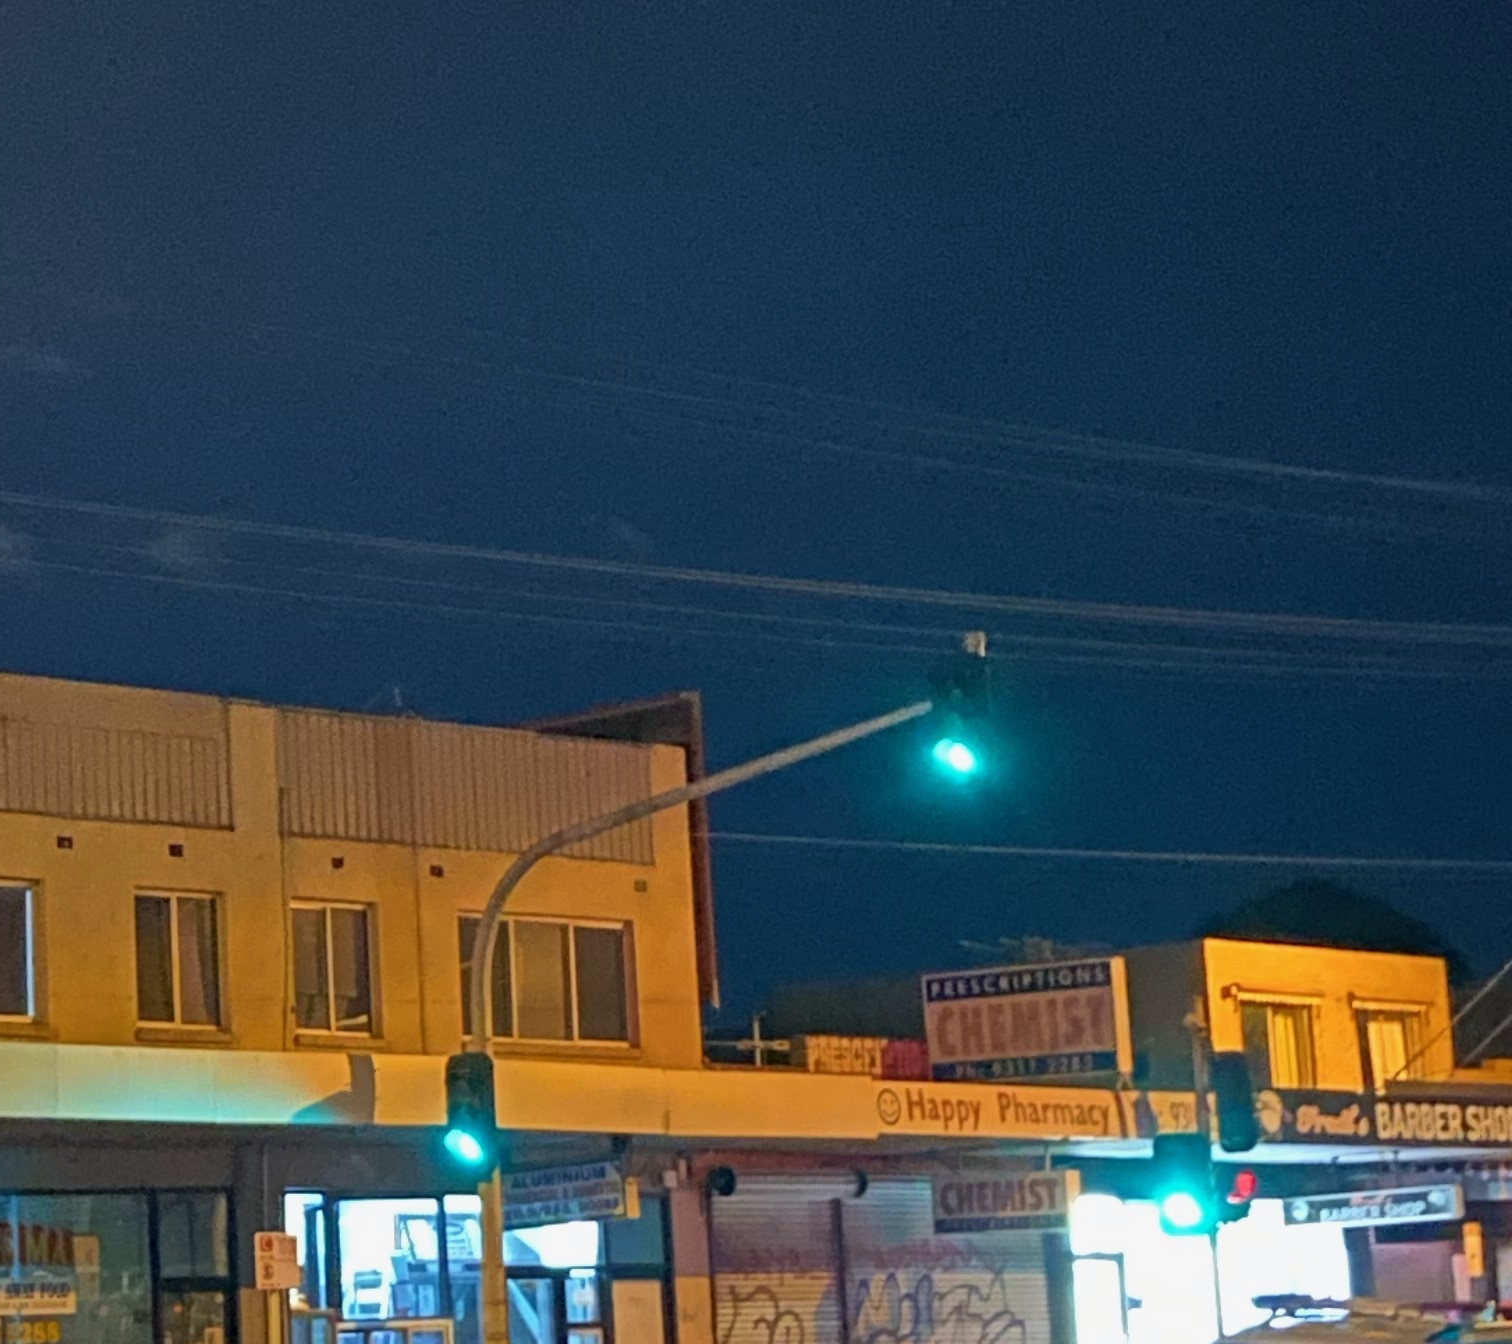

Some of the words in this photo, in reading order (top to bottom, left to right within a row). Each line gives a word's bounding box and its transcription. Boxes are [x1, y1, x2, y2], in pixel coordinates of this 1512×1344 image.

[931, 964, 1107, 998] PRESCRIPTIONS
[937, 992, 1107, 1058] CHEMIST
[905, 1088, 982, 1131] Happy
[997, 1091, 1110, 1136] Pharmacy
[1375, 1101, 1464, 1141] BARBER
[1466, 1104, 1512, 1142] SHO
[511, 1165, 607, 1189] ALUMINIUM
[940, 1178, 1059, 1216] CHEMIST
